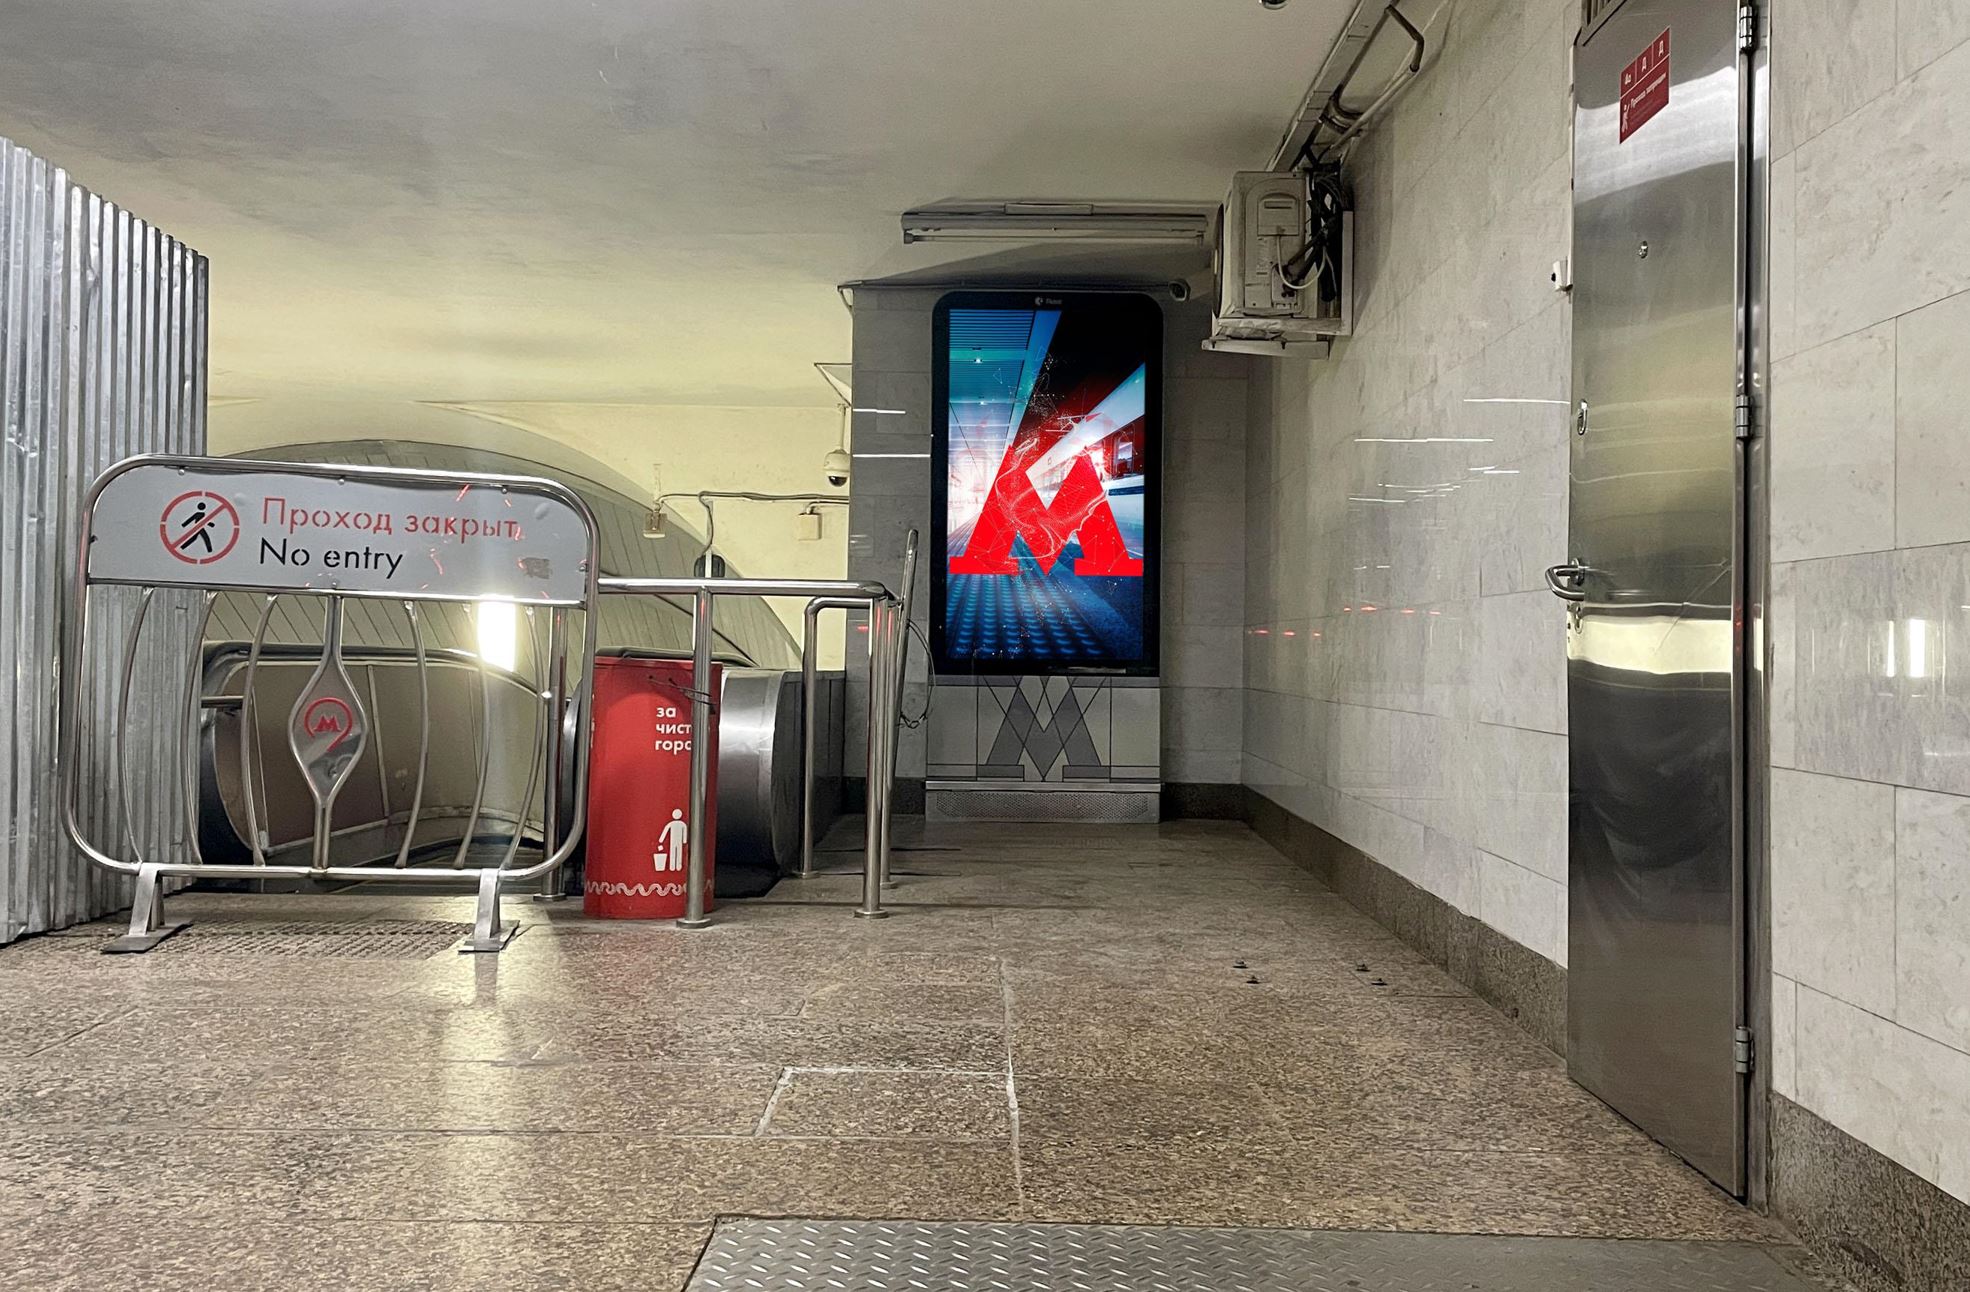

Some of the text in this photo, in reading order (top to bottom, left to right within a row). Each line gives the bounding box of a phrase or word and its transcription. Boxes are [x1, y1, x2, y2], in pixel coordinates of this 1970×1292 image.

[263, 497, 520, 544] Проход закрыт
[260, 537, 403, 579] No entry
[656, 707, 676, 718] за
